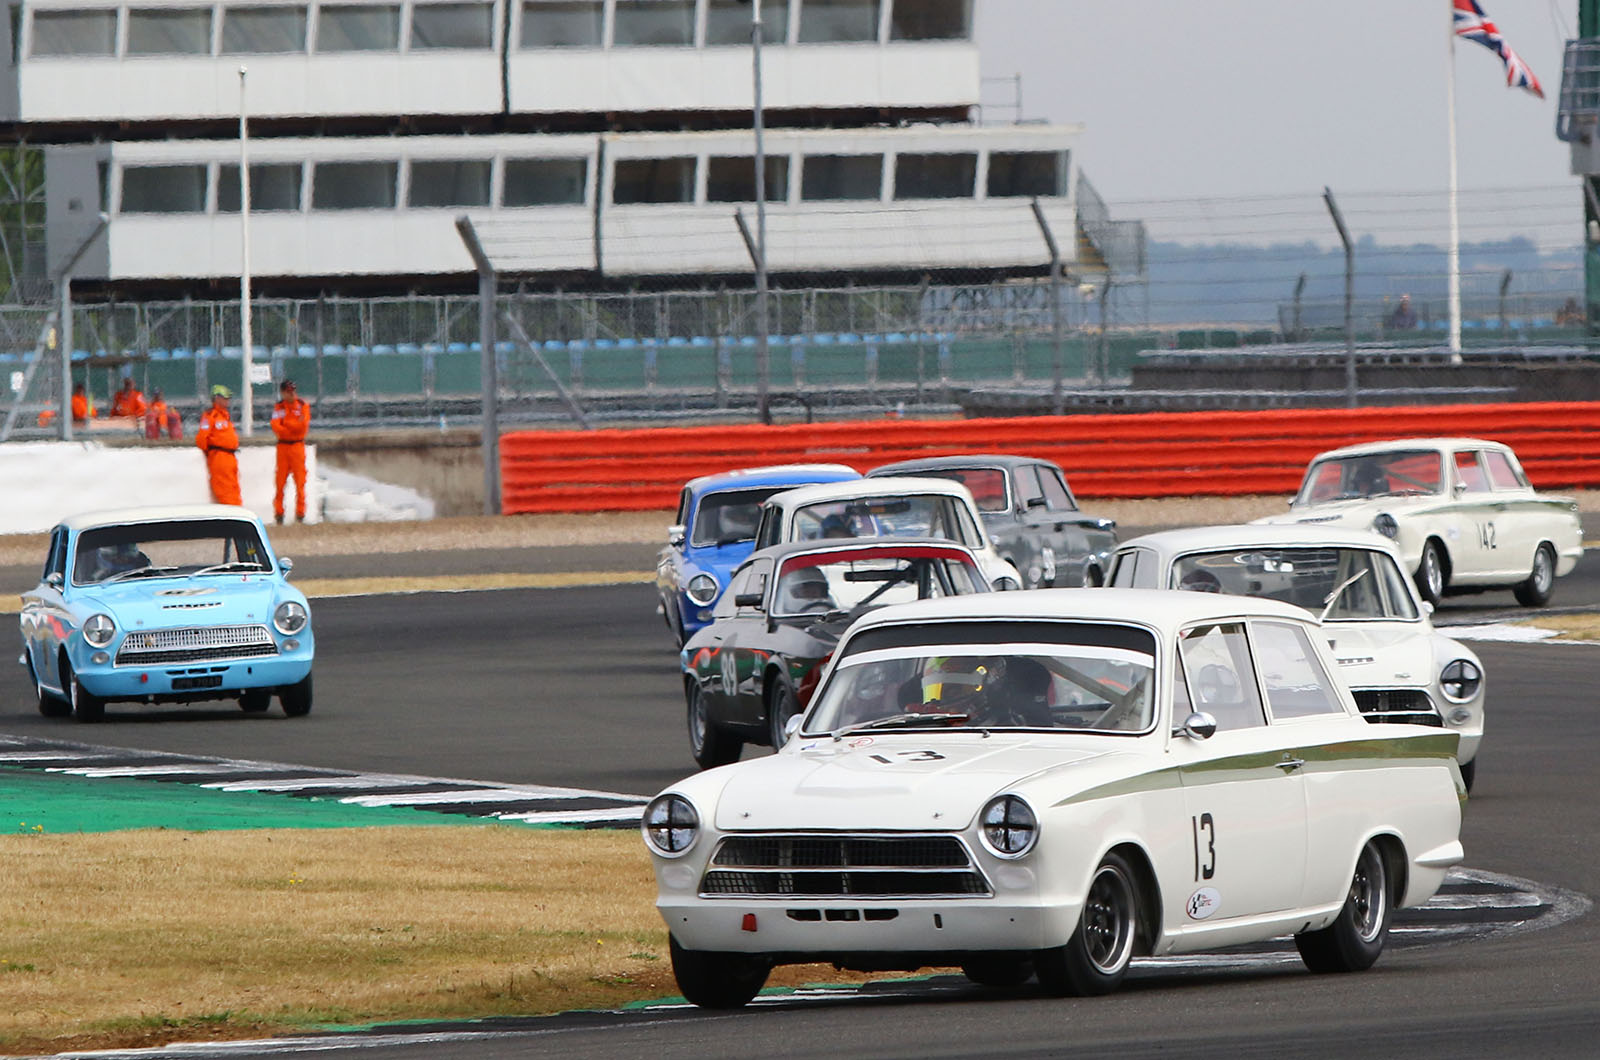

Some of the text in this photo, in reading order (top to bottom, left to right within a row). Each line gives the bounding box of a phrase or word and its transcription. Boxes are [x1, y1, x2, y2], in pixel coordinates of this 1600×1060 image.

[1476, 520, 1497, 550] 142
[721, 651, 737, 696] 89
[869, 750, 947, 764] 13
[1192, 812, 1216, 882] 13
